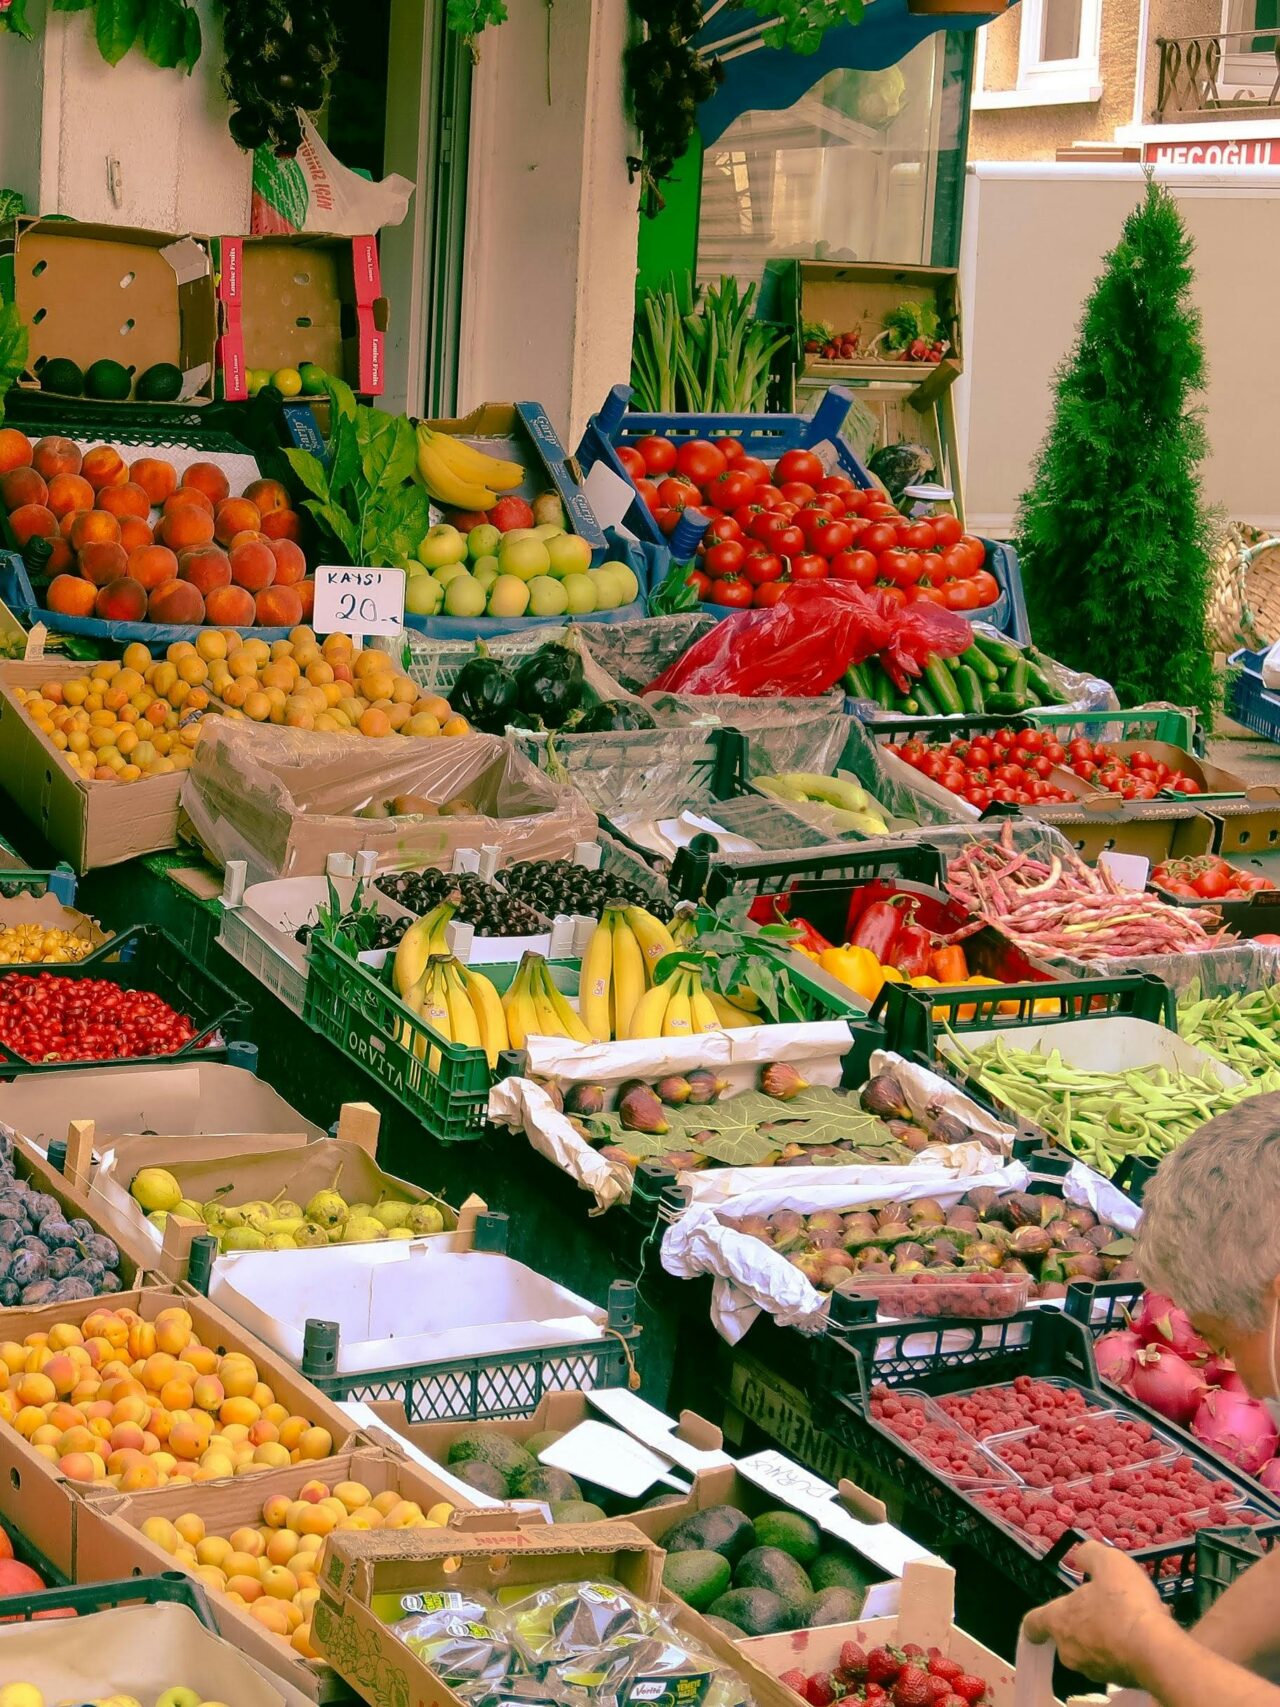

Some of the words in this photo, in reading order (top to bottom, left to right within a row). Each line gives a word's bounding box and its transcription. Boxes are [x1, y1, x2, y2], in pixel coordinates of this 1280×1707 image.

[228, 247, 236, 270] Fruits
[372, 363, 380, 387] Fruits
[535, 414, 560, 447] Garip
[577, 492, 597, 527] Garip
[1039, 811, 1086, 820] SEMSEM
[1143, 806, 1190, 816] SEMSEM
[1206, 802, 1251, 812] SEMSEM
[349, 1031, 403, 1092] ORVITA
[635, 1684, 662, 1697] Verité
